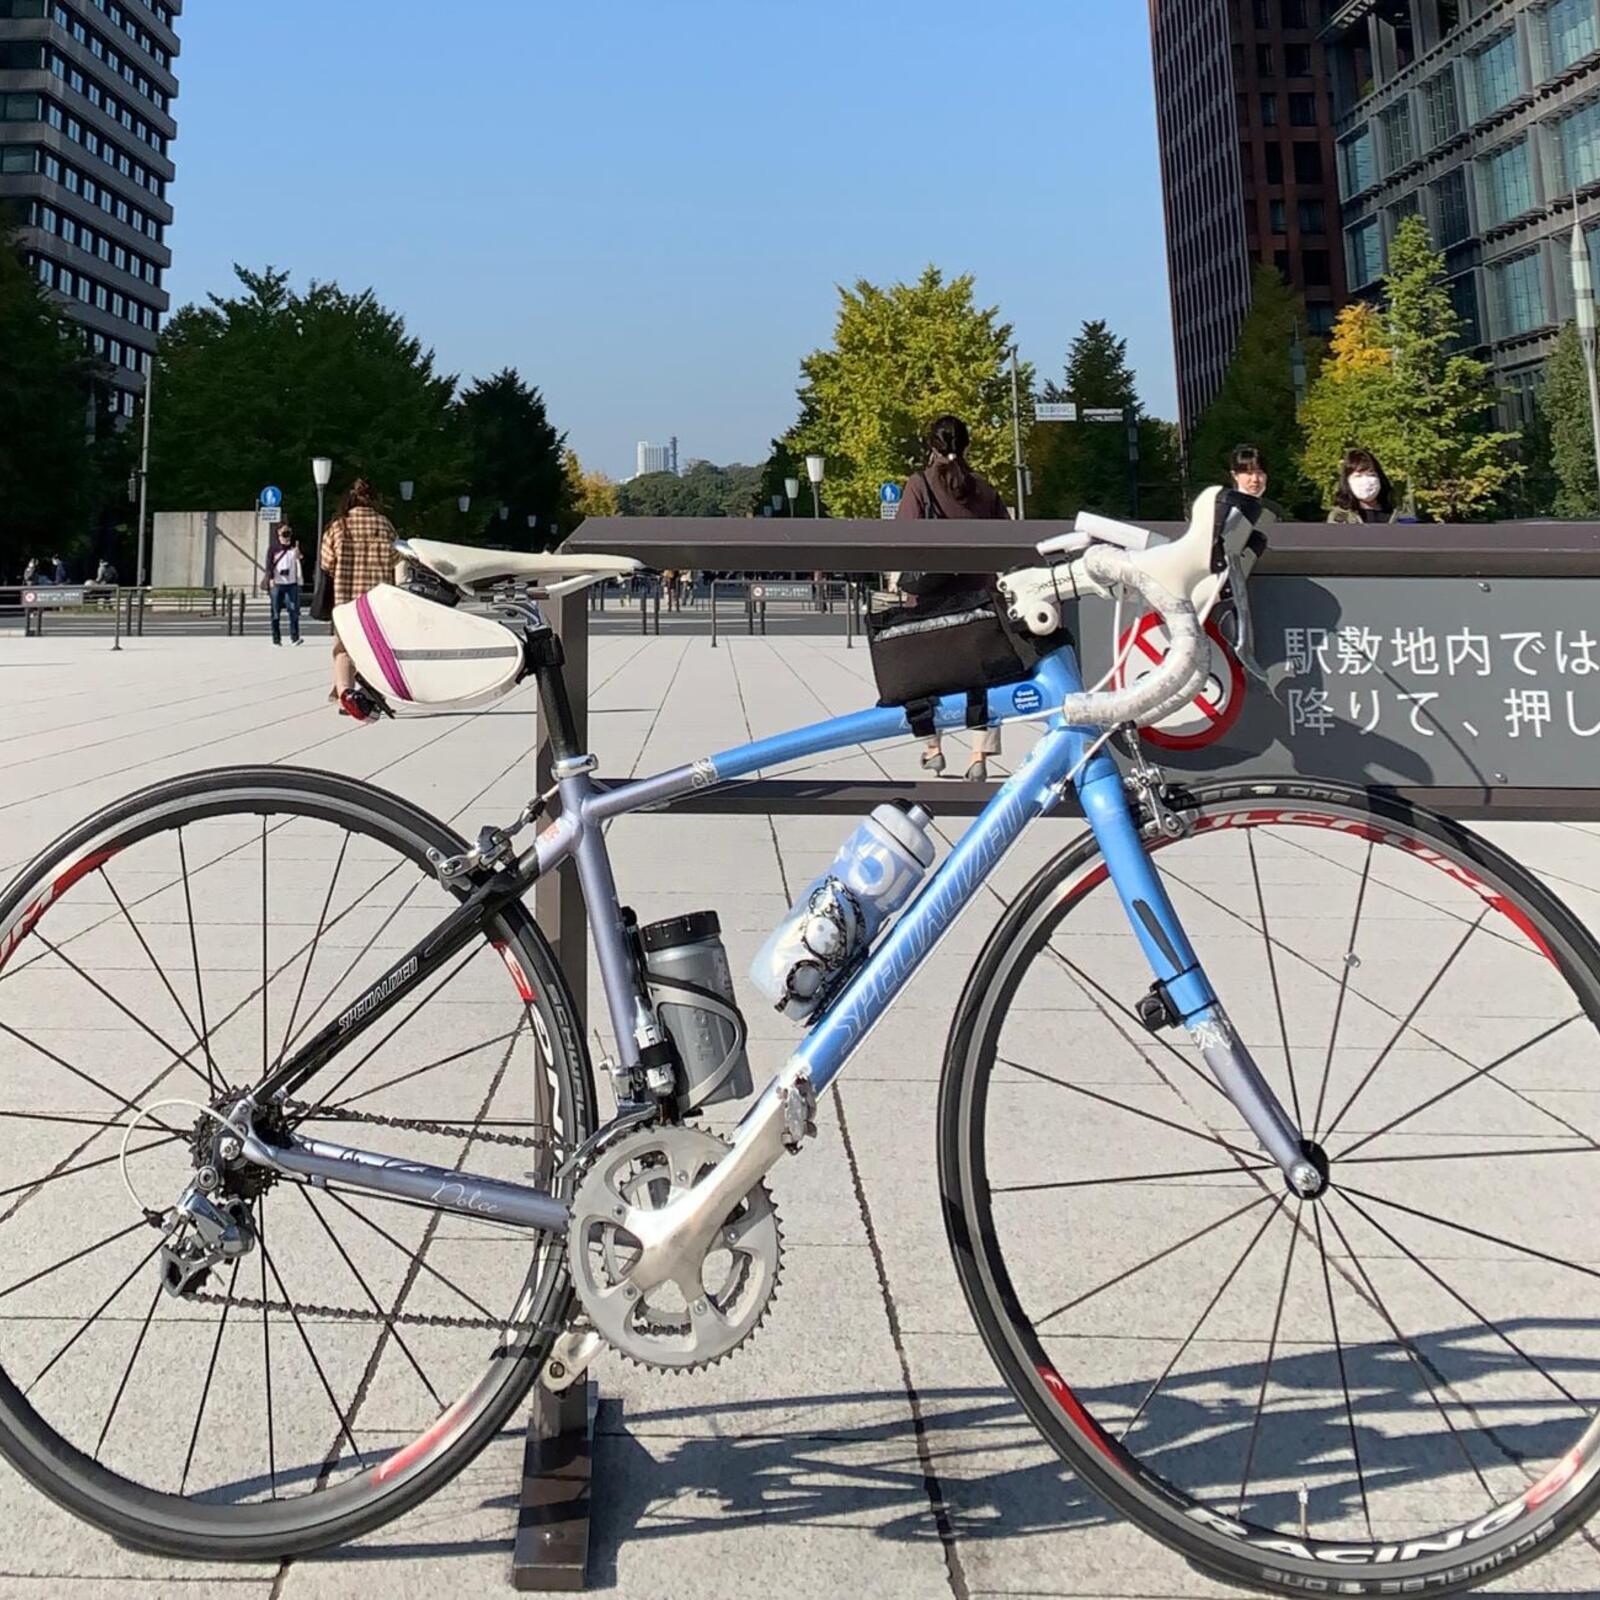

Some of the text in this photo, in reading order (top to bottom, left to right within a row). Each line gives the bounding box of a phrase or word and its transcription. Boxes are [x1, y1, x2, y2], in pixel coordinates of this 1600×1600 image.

[1284, 626, 1600, 676] 駅敷地内では
[1287, 687, 1600, 738] 降りて、押し
[338, 955, 419, 1036] SPECIALIZED
[431, 1182, 503, 1213] Dolce
[1184, 1501, 1526, 1564] RACING
[1381, 1520, 1556, 1593] SCHWALBE
